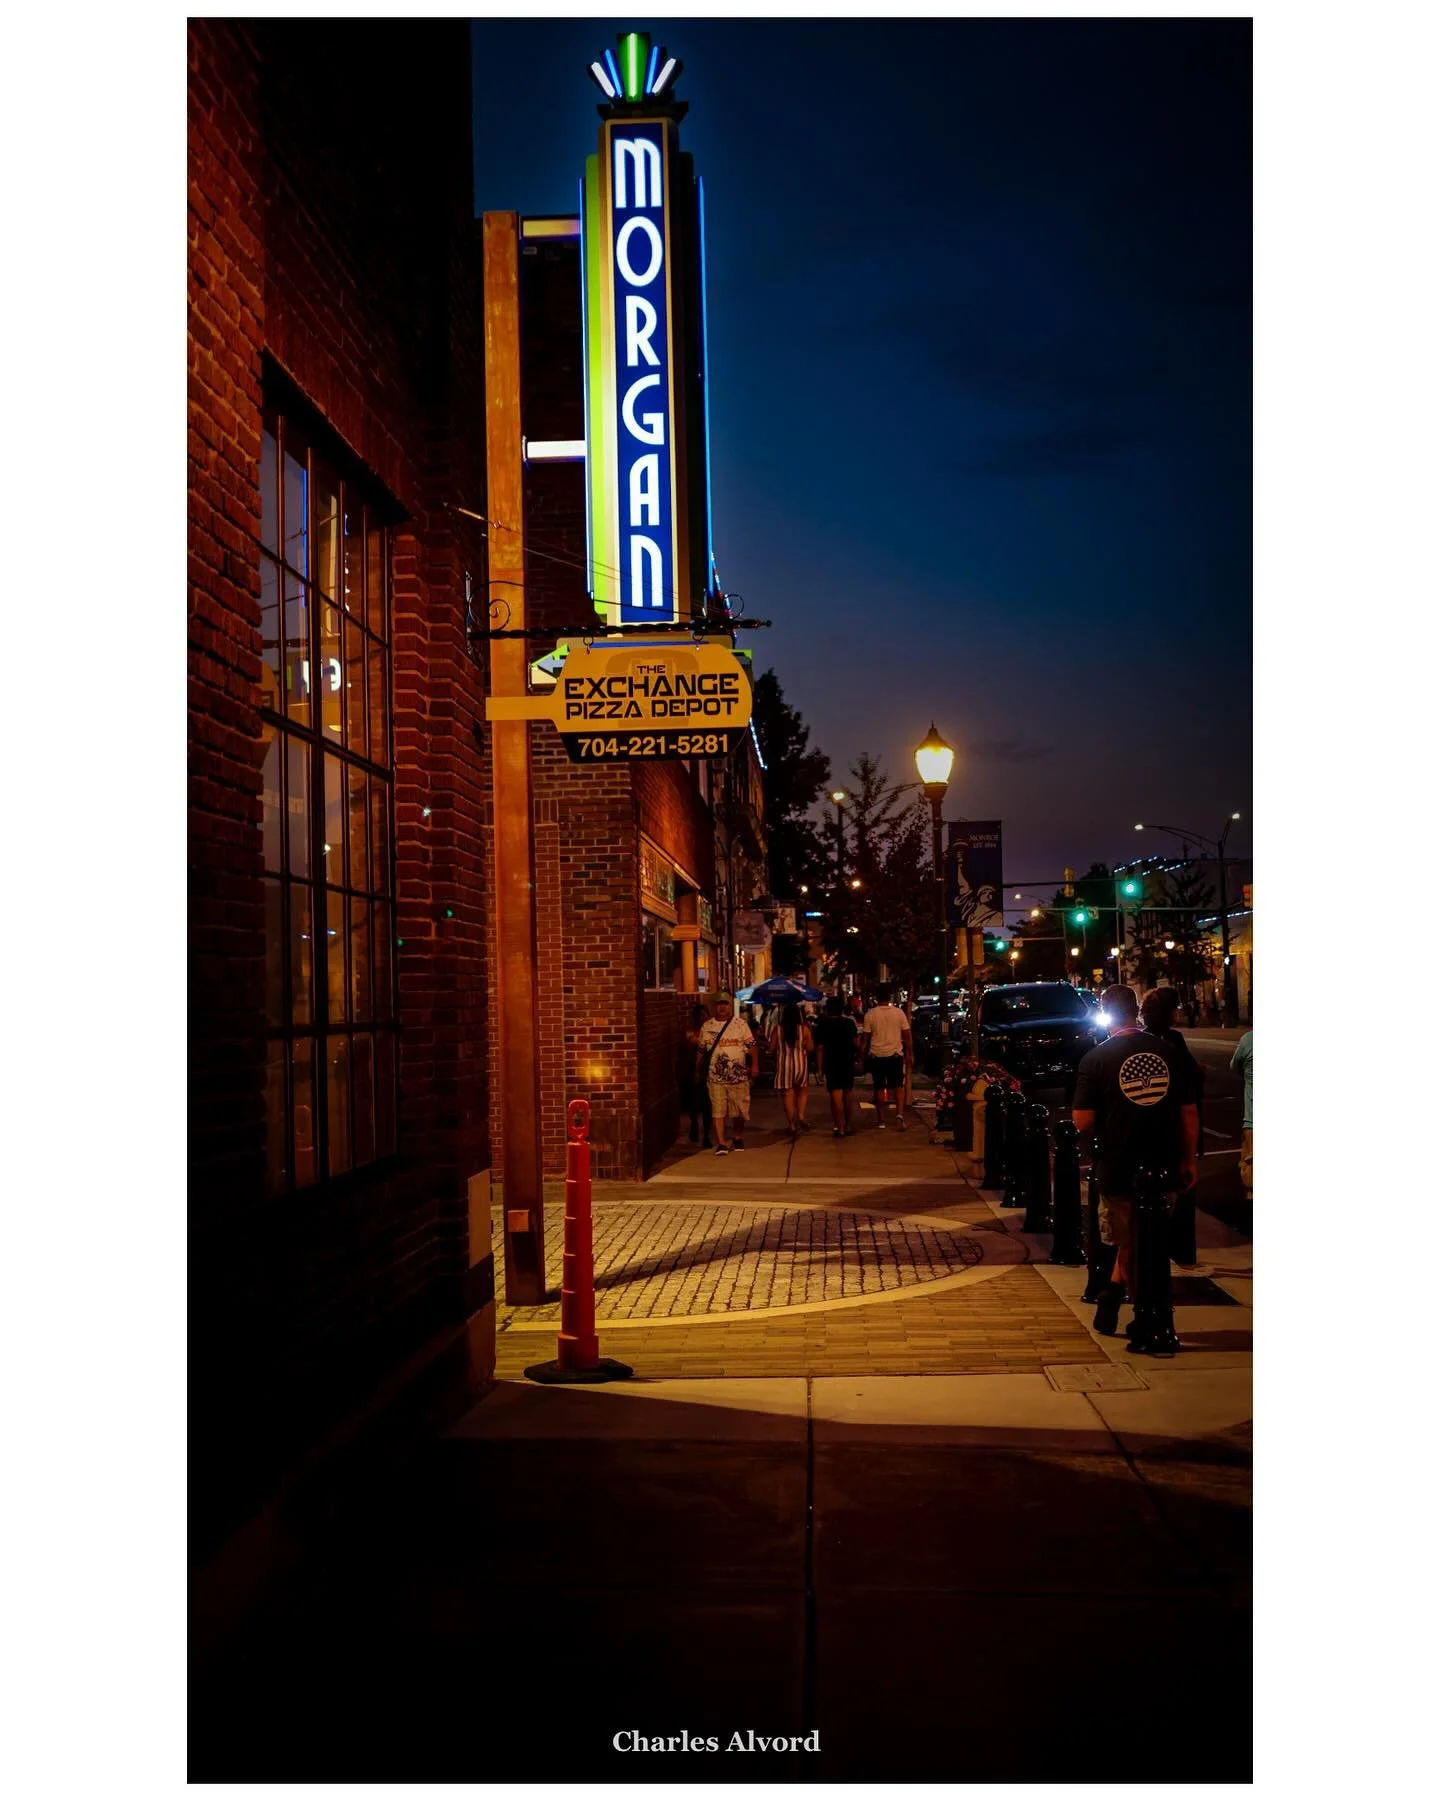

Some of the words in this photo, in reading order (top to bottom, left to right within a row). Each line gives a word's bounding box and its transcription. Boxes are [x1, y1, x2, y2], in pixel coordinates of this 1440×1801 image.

[614, 137, 665, 608] MORGAN
[636, 664, 666, 674] THE
[564, 673, 739, 699] EXCHANGE
[566, 700, 643, 720] PIZZA
[652, 698, 738, 717] DEPOT
[577, 733, 729, 757] 704-221-5281
